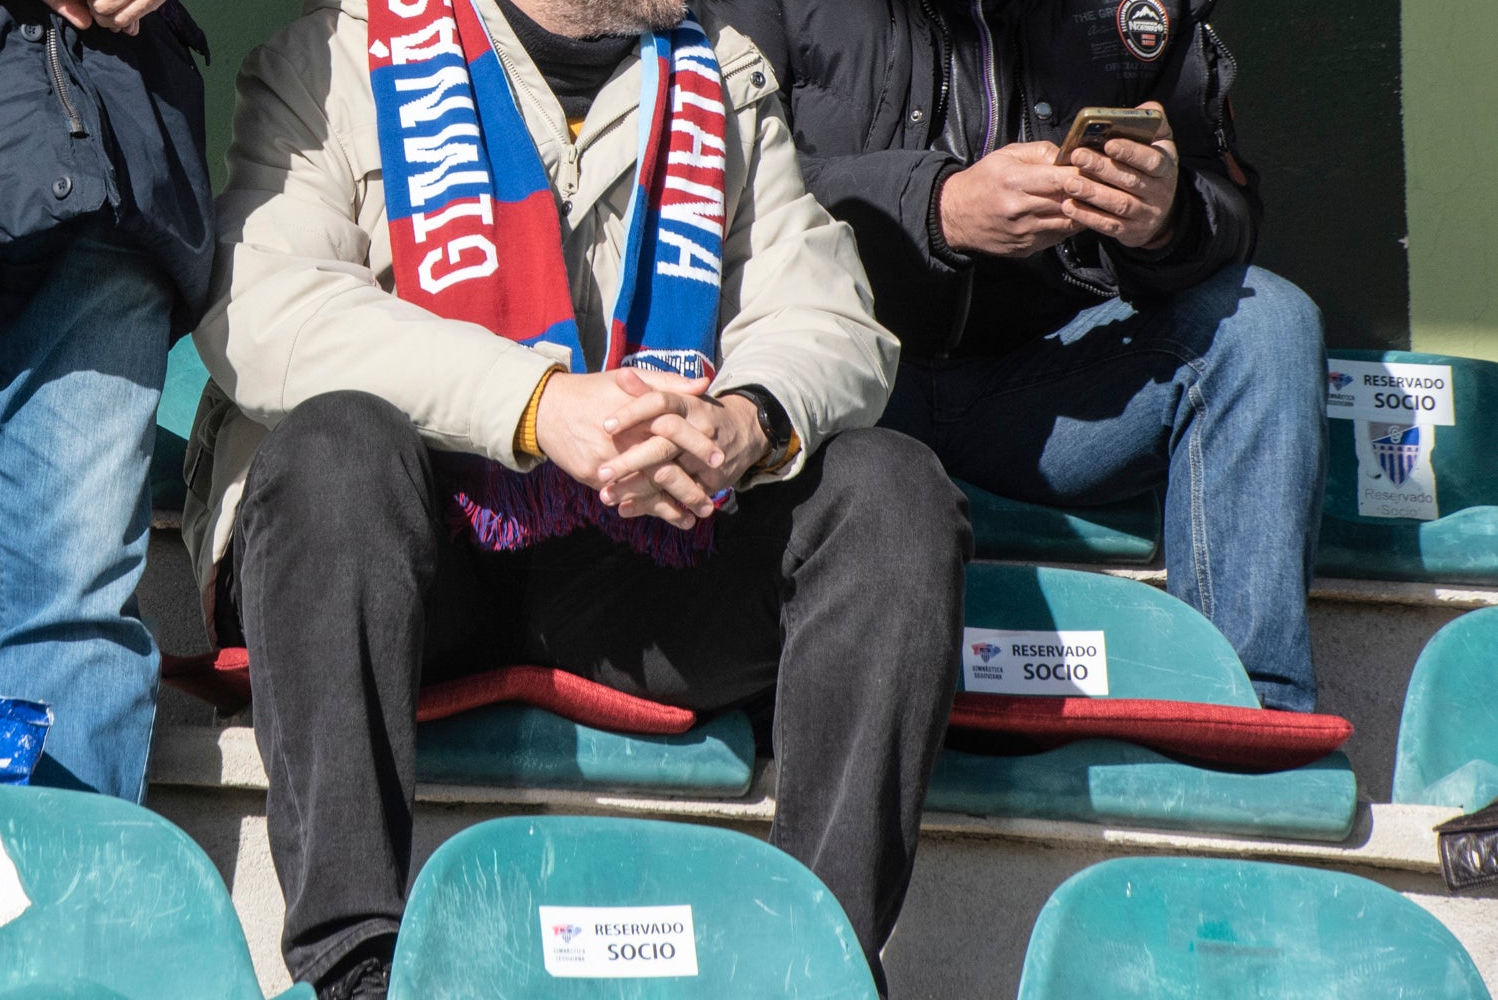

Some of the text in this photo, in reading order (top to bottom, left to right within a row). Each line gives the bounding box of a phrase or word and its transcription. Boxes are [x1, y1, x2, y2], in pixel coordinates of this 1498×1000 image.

[1363, 374, 1445, 390] RESERVADO
[1374, 392, 1436, 411] SOCIO
[1012, 643, 1097, 657] RESERVADO
[1023, 662, 1089, 681] SOCIO
[594, 921, 684, 936] RESERVADO
[607, 942, 676, 961] SOCIO
